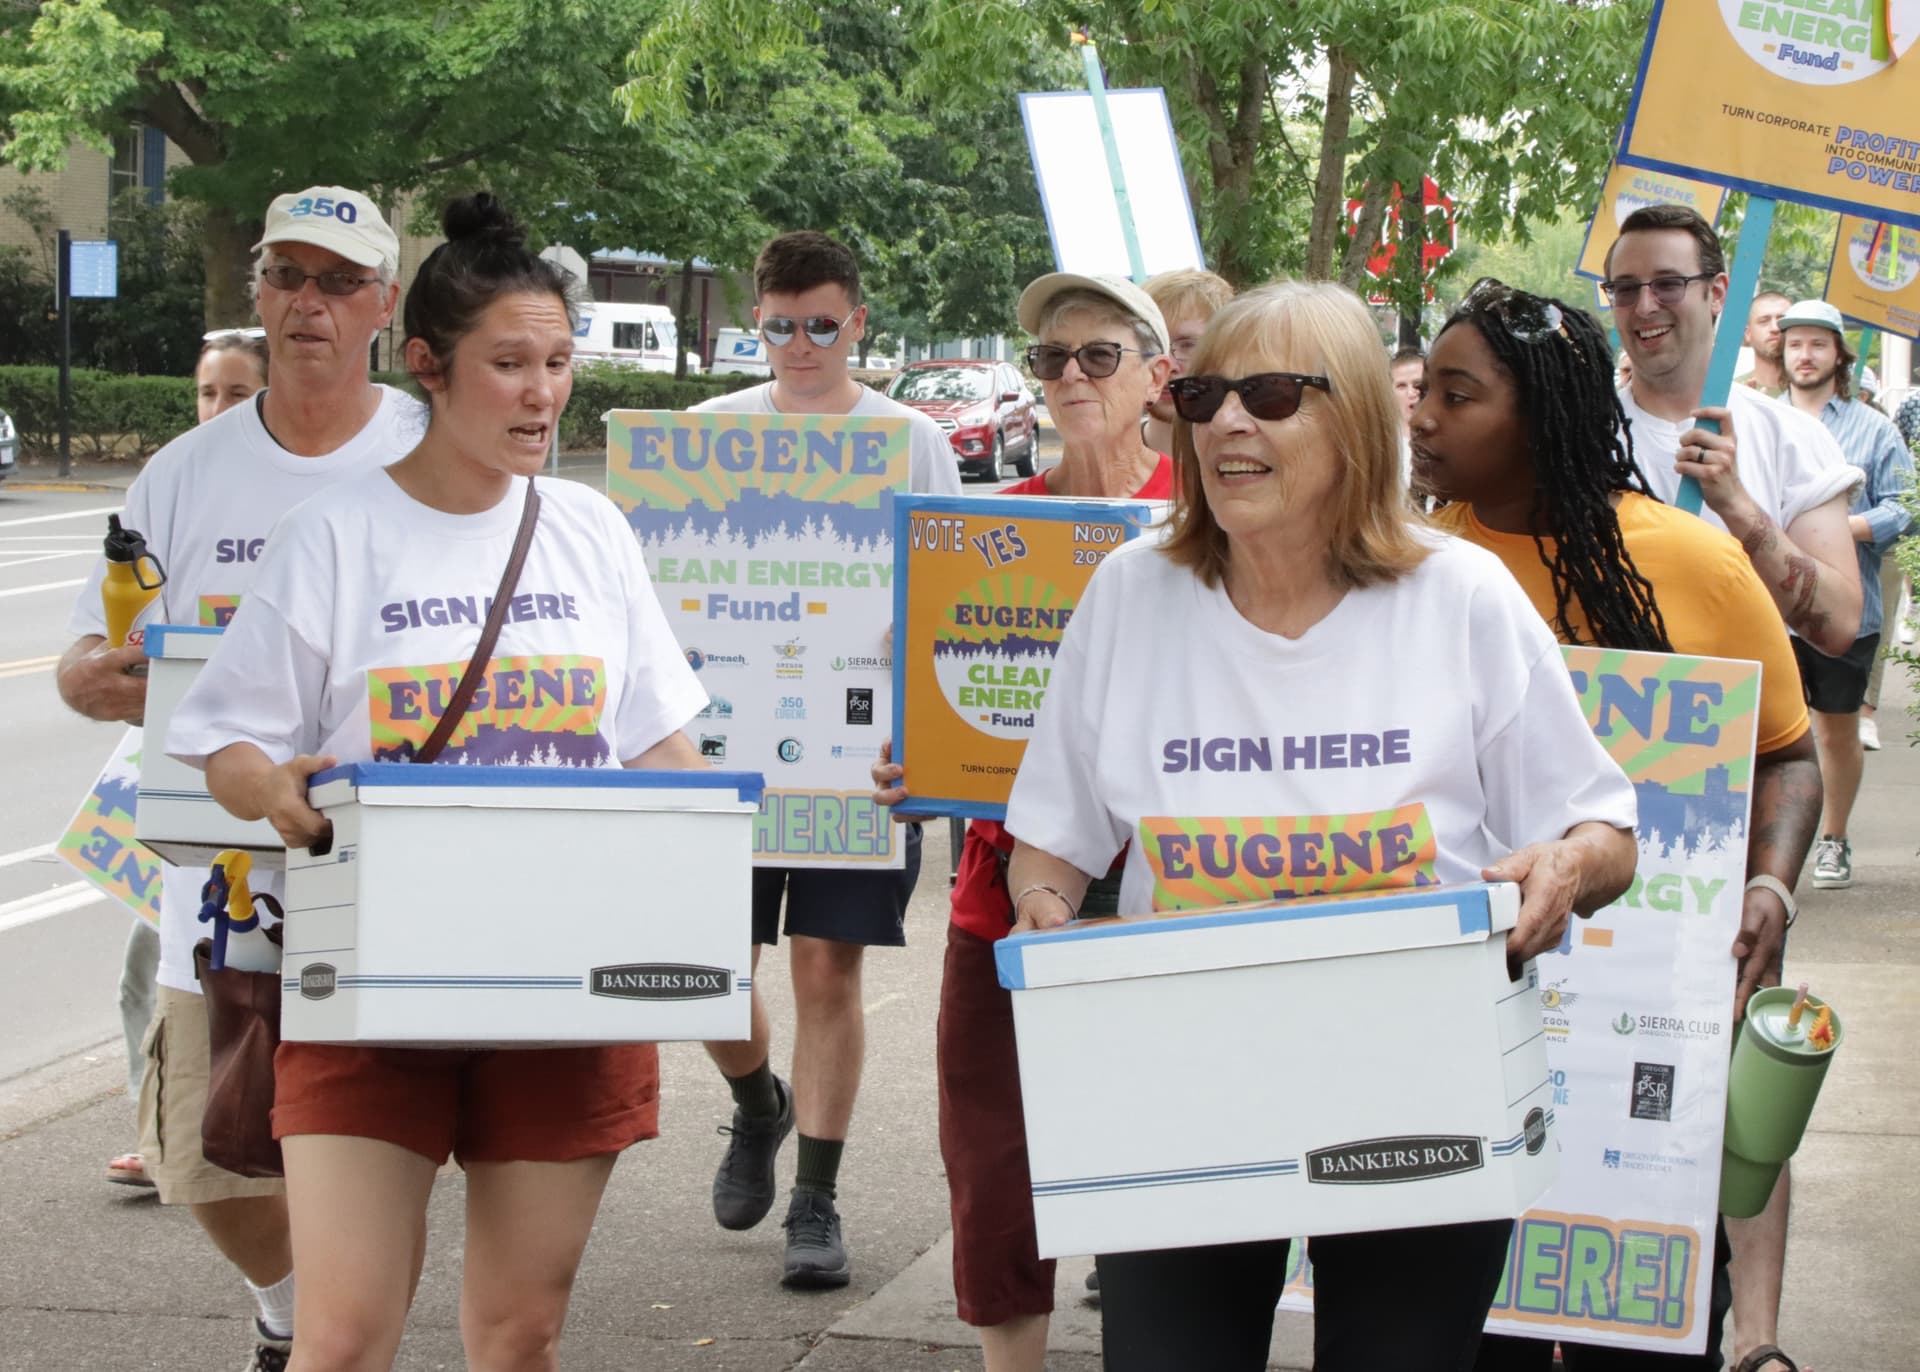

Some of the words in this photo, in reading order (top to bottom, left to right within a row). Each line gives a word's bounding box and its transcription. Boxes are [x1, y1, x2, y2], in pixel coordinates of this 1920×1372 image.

[1738, 1, 1870, 53] ENERG
[1778, 43, 1840, 71] Fund
[1722, 104, 1754, 120] TURN
[1757, 112, 1831, 136] CORPORATE
[1825, 144, 1855, 158] INTO
[290, 198, 357, 224] 350
[628, 427, 887, 475] EUGENE
[910, 517, 965, 552] VOTE
[970, 523, 1028, 569] YES
[1073, 524, 1121, 544] NOV
[216, 538, 266, 563] SIG
[645, 557, 737, 585] EAN
[748, 560, 893, 588] ENERGY
[380, 595, 478, 633] SIGN
[707, 592, 800, 621] Fund
[848, 656, 878, 667] SIERRA
[880, 658, 892, 667] CLU
[780, 697, 804, 708] 350
[849, 699, 869, 711] PSR
[958, 686, 1045, 710] ENER
[992, 712, 1035, 728] Fund
[1162, 736, 1273, 773] SIGN
[1283, 728, 1412, 771] HERE
[961, 764, 985, 774] TURN
[986, 766, 1017, 776] CORPO
[752, 794, 891, 857] HERE!
[1157, 822, 1418, 880] EUGENE
[601, 974, 680, 989] BANKERS
[684, 974, 721, 989] BOX
[1542, 1016, 1570, 1027] EGON
[1639, 1015, 1685, 1032] SIERRA
[1688, 1020, 1720, 1035] CLUB
[1638, 1079, 1668, 1098] PSR
[1320, 1150, 1419, 1174] BANKERS
[1424, 1144, 1471, 1165] BOX
[1493, 1218, 1692, 1330] ERE!
